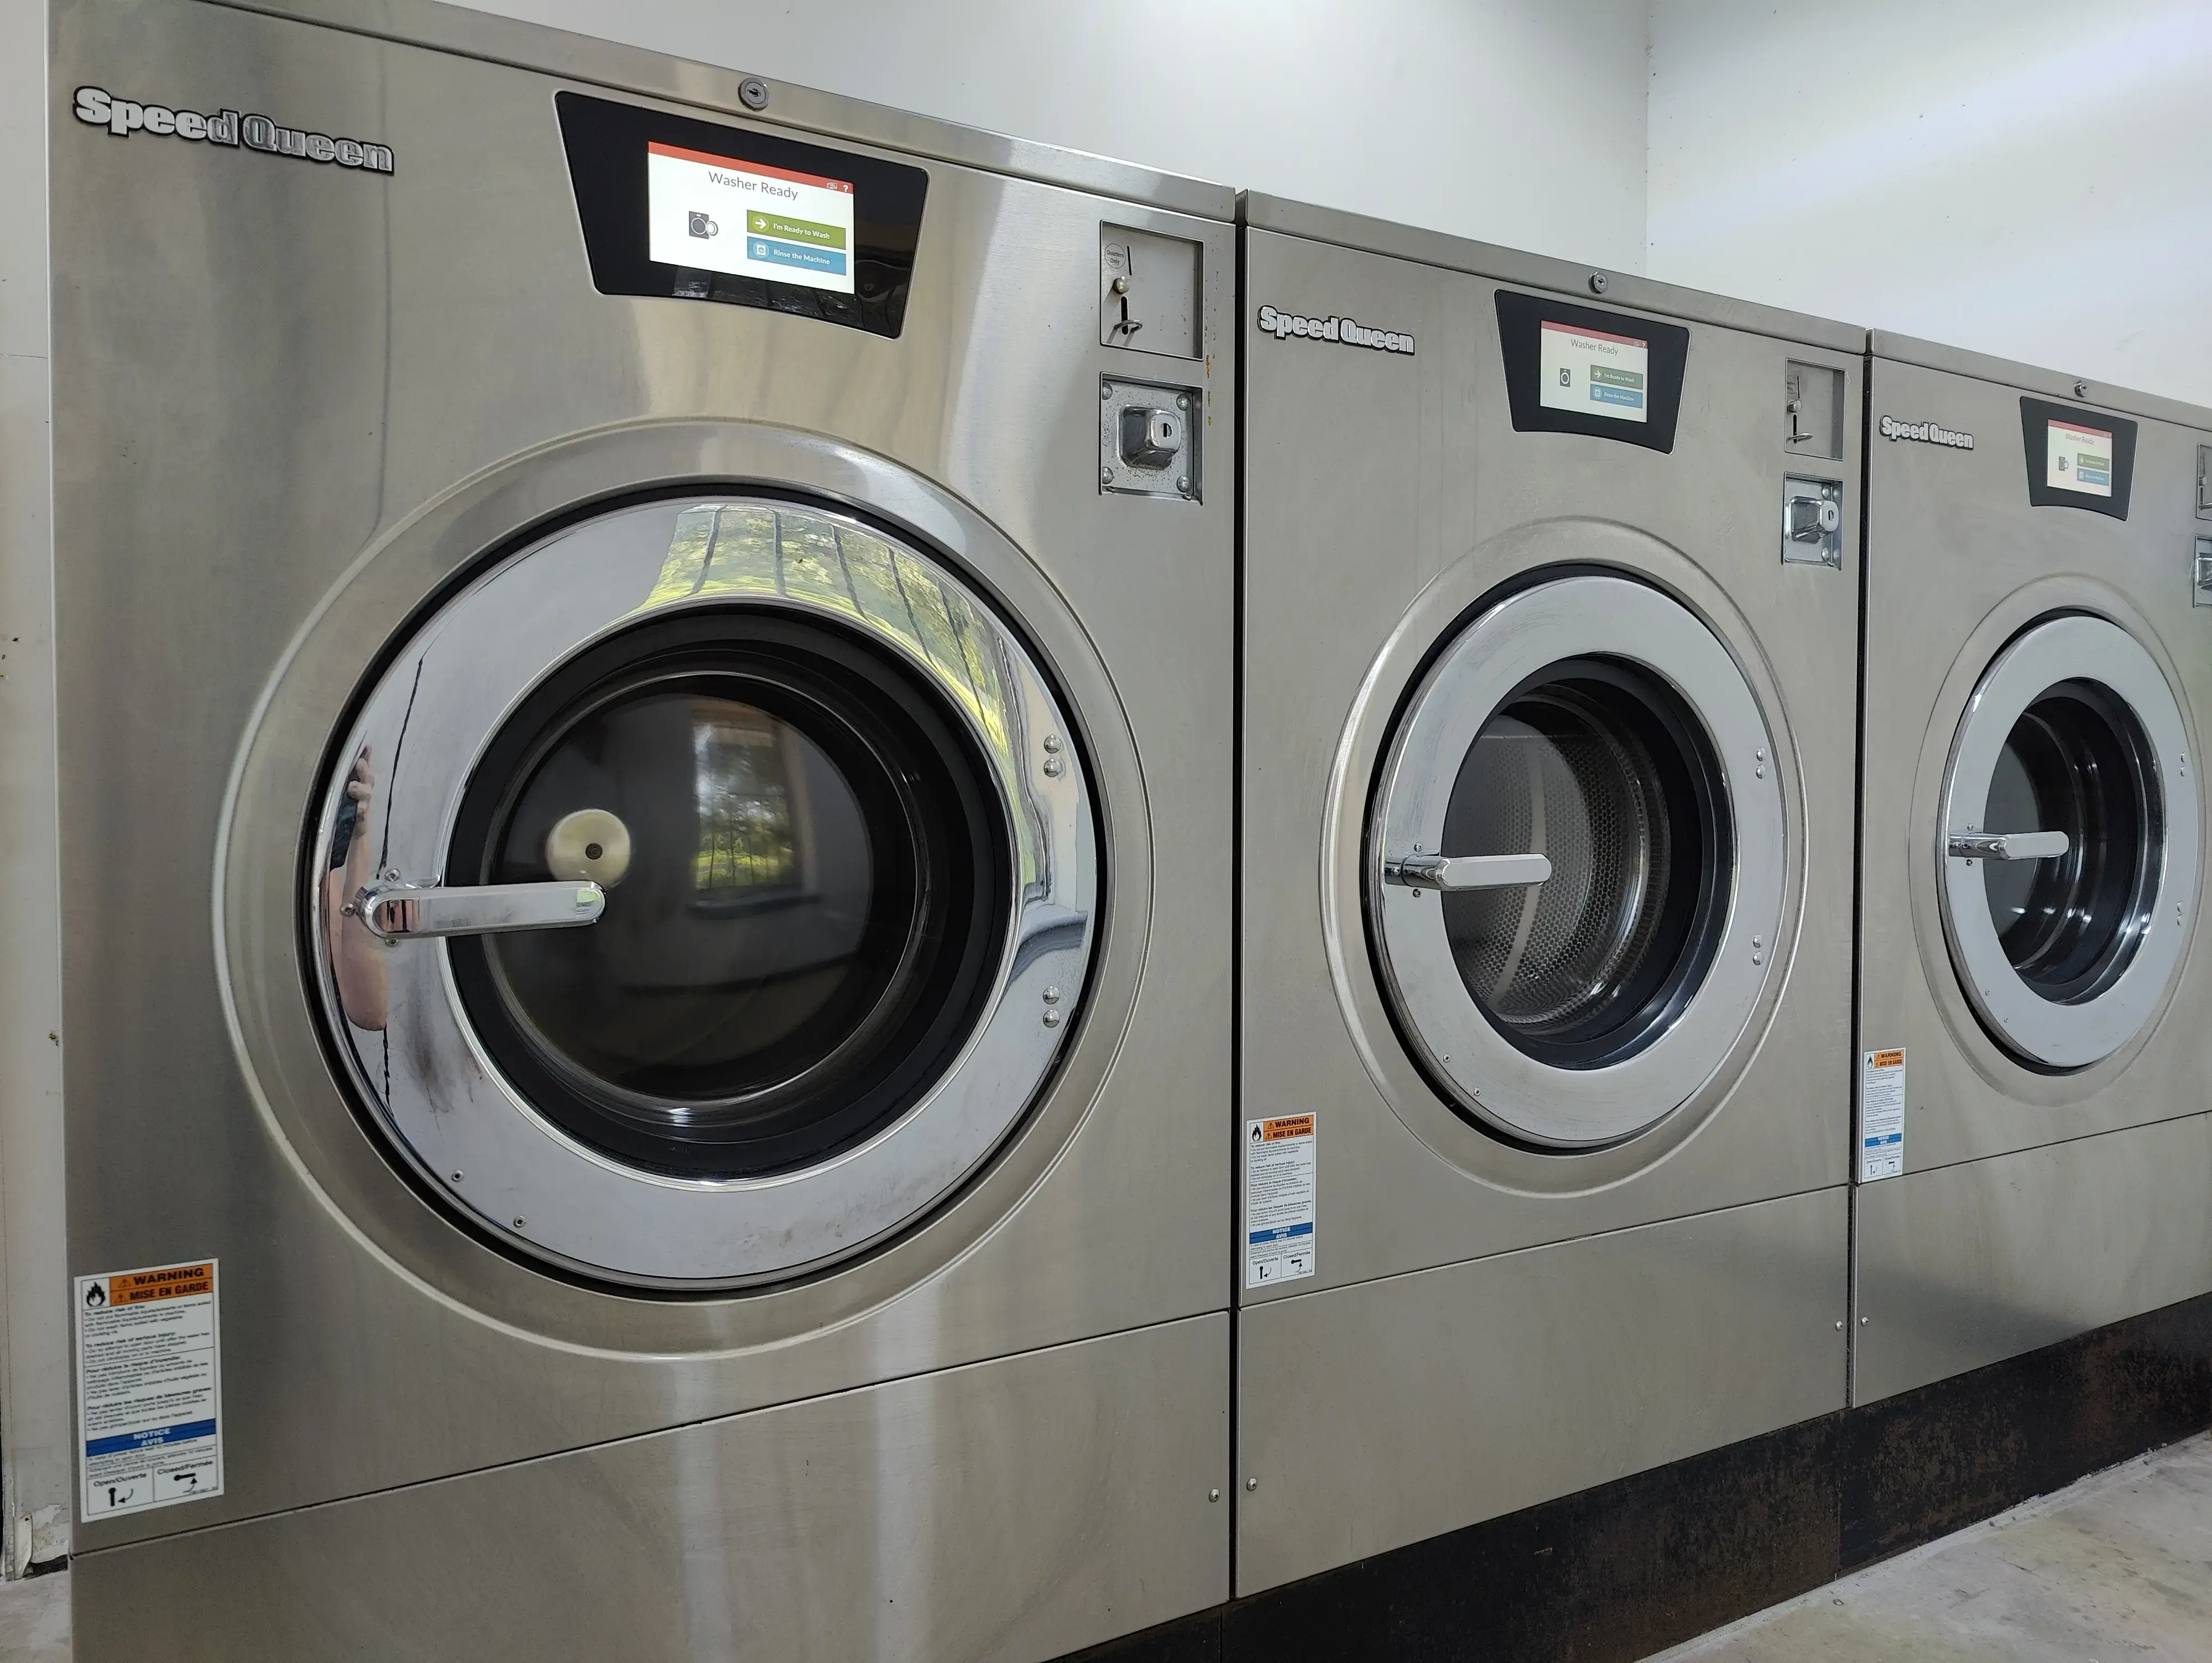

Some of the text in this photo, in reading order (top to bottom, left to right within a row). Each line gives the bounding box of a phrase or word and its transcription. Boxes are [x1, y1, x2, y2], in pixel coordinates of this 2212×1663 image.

[73, 86, 394, 175] Speed Queen
[708, 171, 798, 201] Washer Ready
[784, 225, 804, 236] Ready
[812, 230, 830, 239] Wash
[774, 249, 790, 258] Rinse
[804, 255, 830, 265] Machine
[1107, 250, 1124, 258] Quarters
[1258, 305, 1415, 355] Speed Queen
[1571, 338, 1618, 356] Washer Ready
[1880, 416, 1973, 450] Speed Queen
[2065, 433, 2095, 445] Washer Ready
[1275, 1117, 1310, 1128] WARNING
[1295, 1127, 1312, 1135] GARDE
[133, 1268, 204, 1285] WARNING
[130, 1282, 208, 1300] MISE EN GARDE
[133, 1427, 171, 1441] NOTICE
[140, 1437, 164, 1447] AVIS
